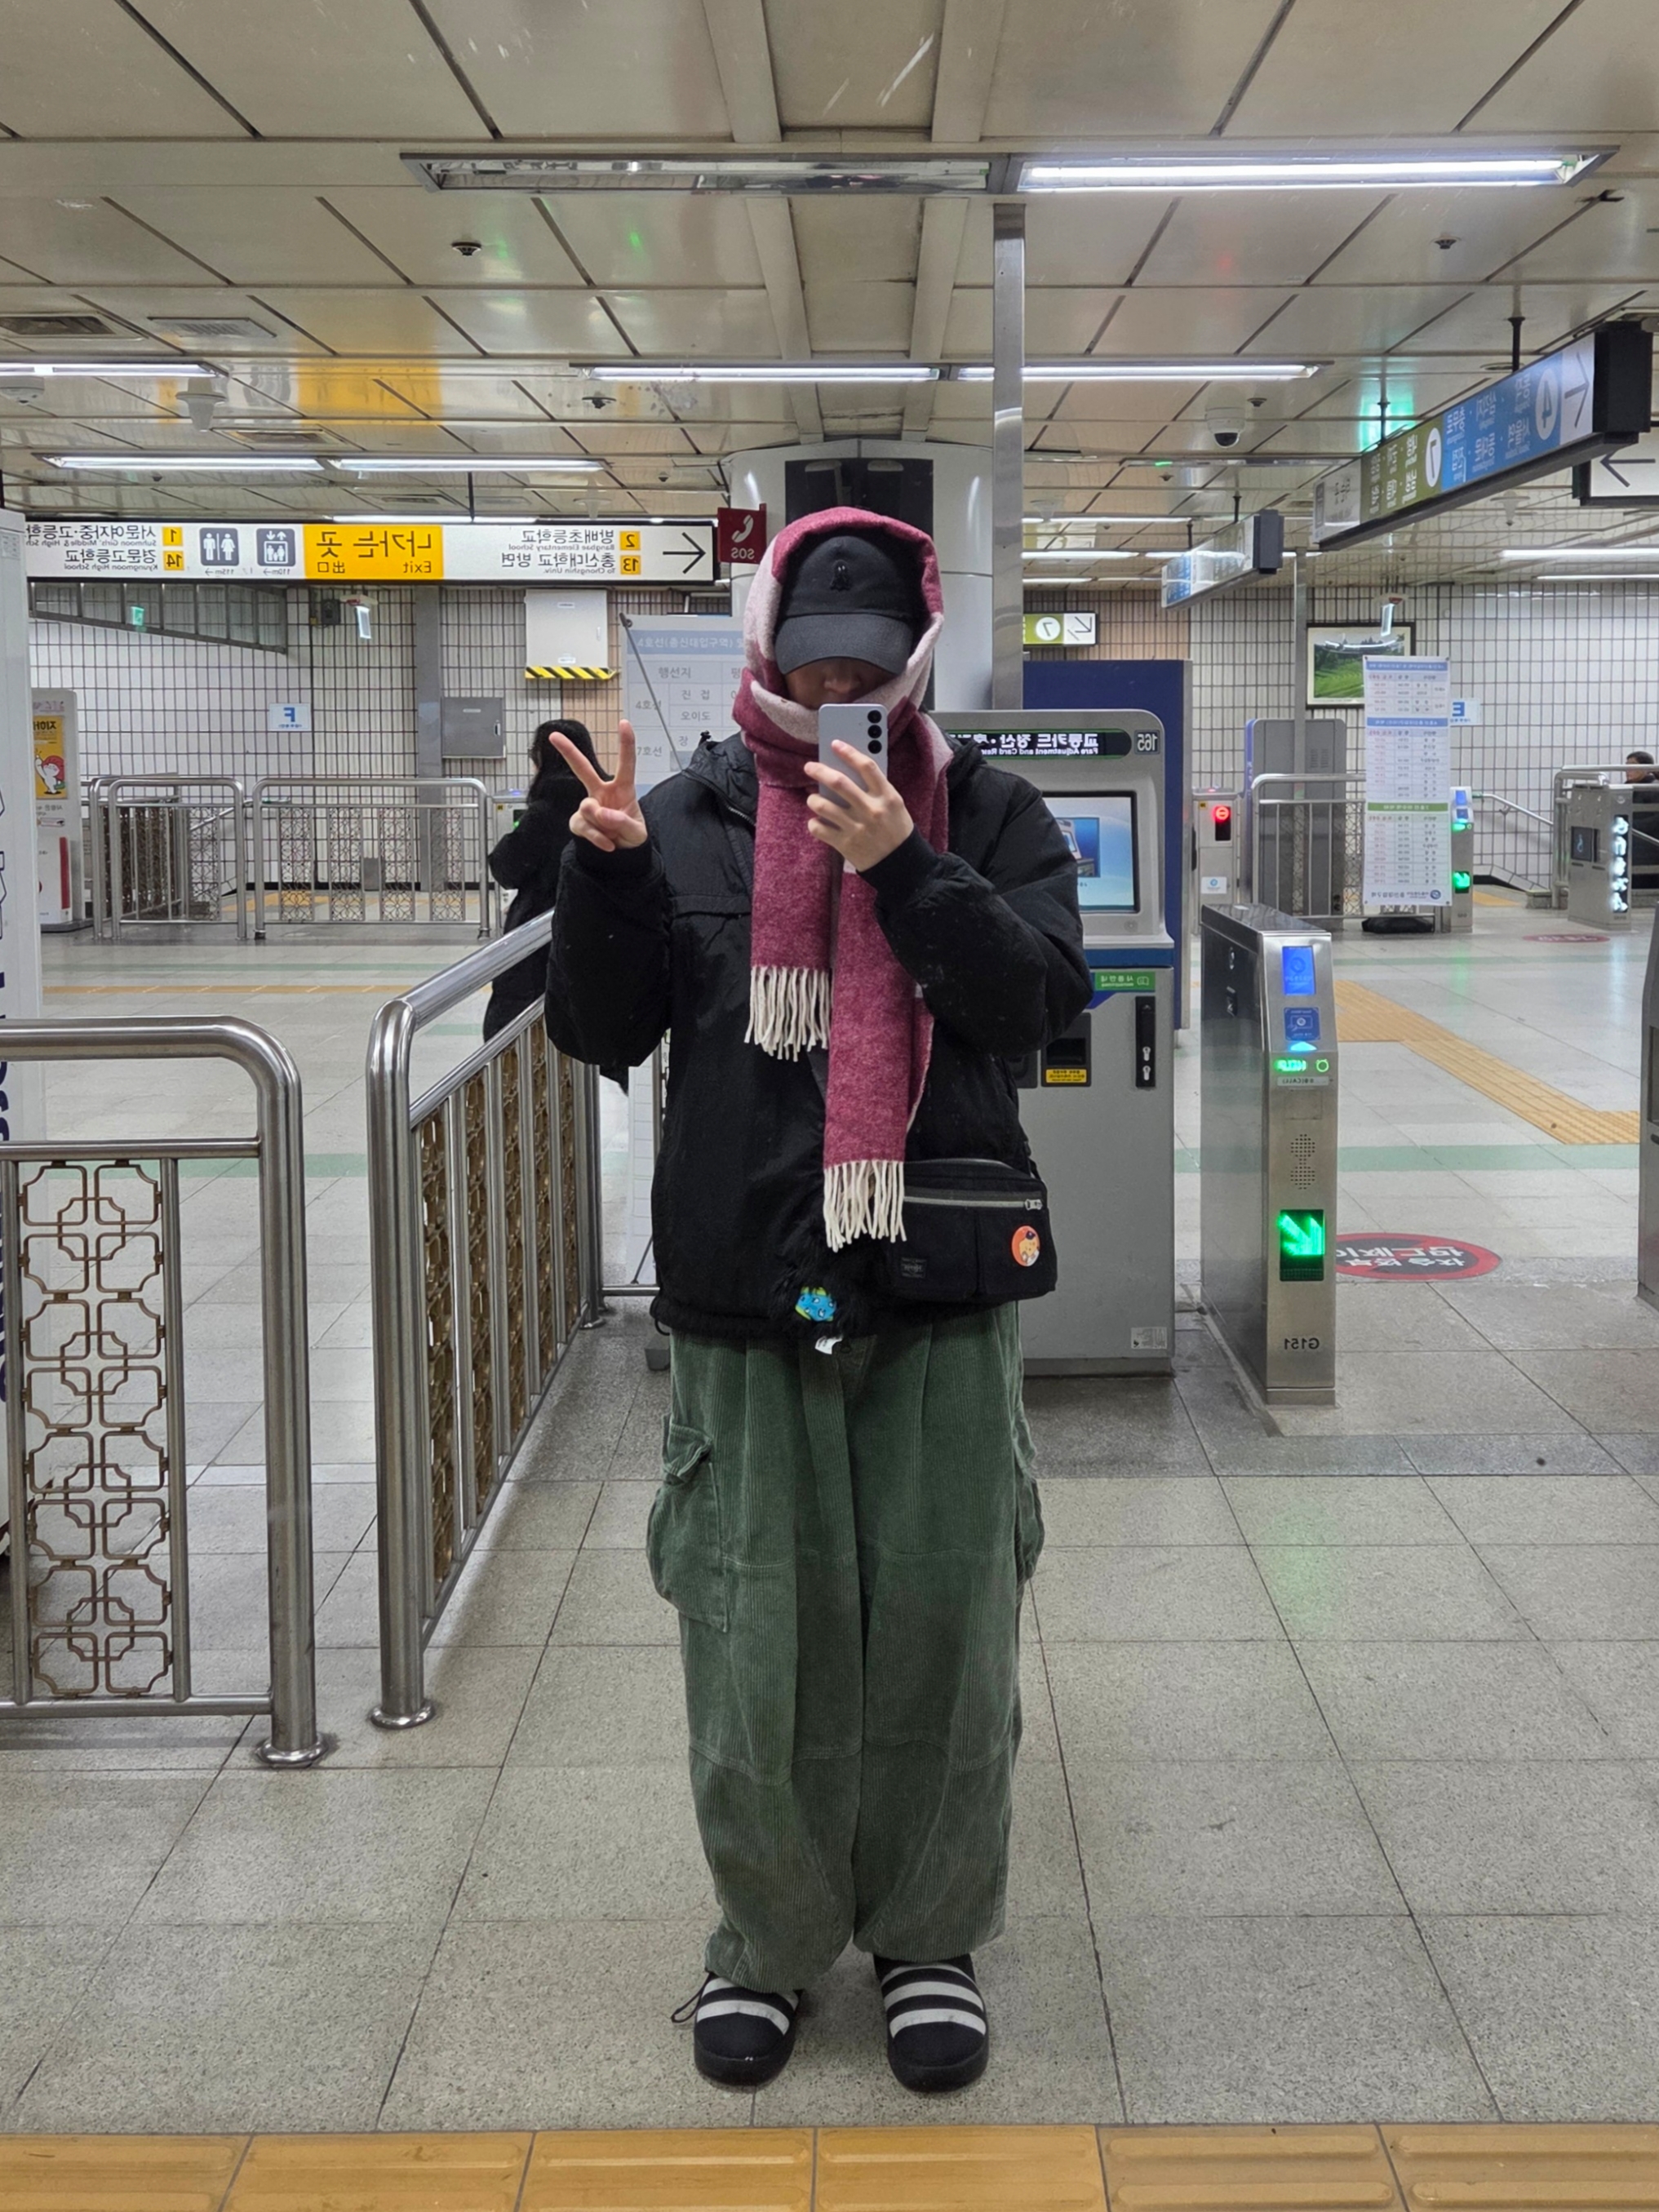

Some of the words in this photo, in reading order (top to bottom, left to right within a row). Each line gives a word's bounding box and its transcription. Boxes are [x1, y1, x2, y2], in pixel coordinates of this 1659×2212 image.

[658, 667, 691, 678] 행선지
[681, 711, 711, 721] 오이도
[637, 747, 663, 757] 7호선
